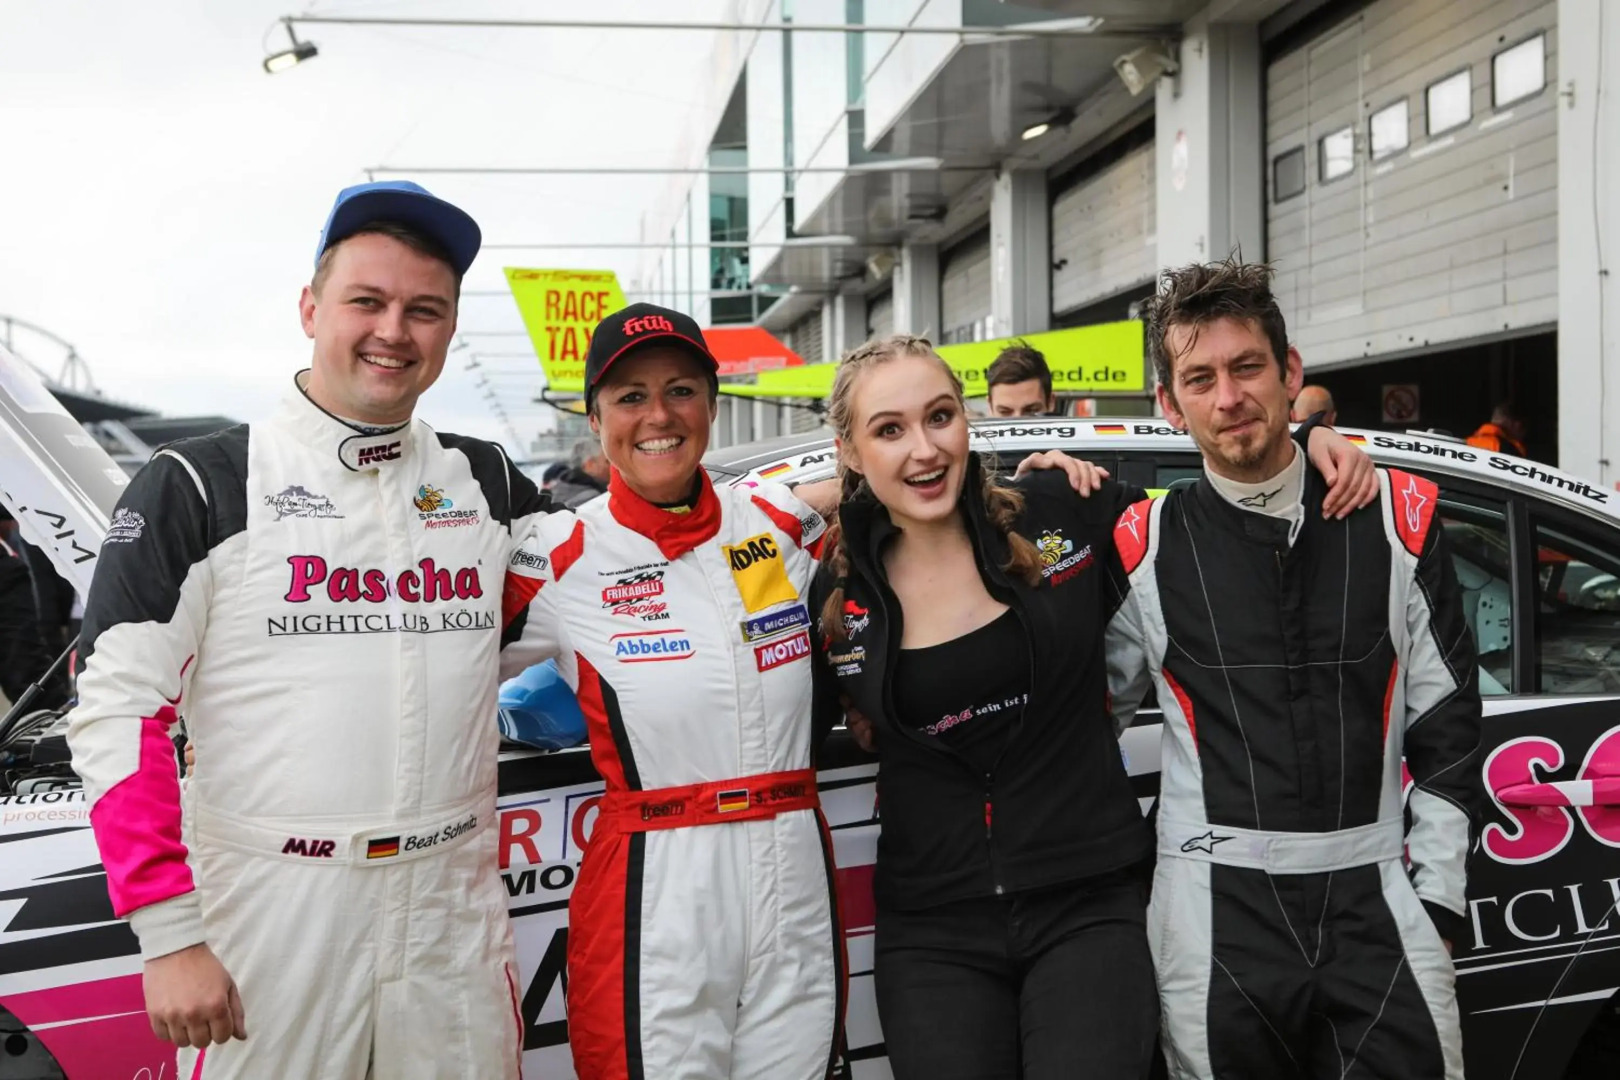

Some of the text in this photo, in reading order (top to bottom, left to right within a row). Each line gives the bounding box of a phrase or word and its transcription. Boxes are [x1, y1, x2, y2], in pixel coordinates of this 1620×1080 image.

[545, 290, 610, 322] RACE
[622, 315, 673, 335] früh
[1373, 435, 1609, 504] Sabine Schmitz
[418, 510, 478, 520] SPEEDBEAT
[1042, 545, 1091, 578] SPEEDBEAT
[284, 555, 483, 603] Pascha
[606, 582, 660, 600] FRIKADELLI
[611, 600, 667, 617] Racing
[640, 612, 670, 622] TEAM
[268, 609, 495, 634] NIGHTCLUB KÖLN
[616, 637, 691, 656] Abbelen
[761, 636, 809, 667] MOTUL
[1004, 697, 1020, 708] ist
[404, 832, 440, 851] Beat
